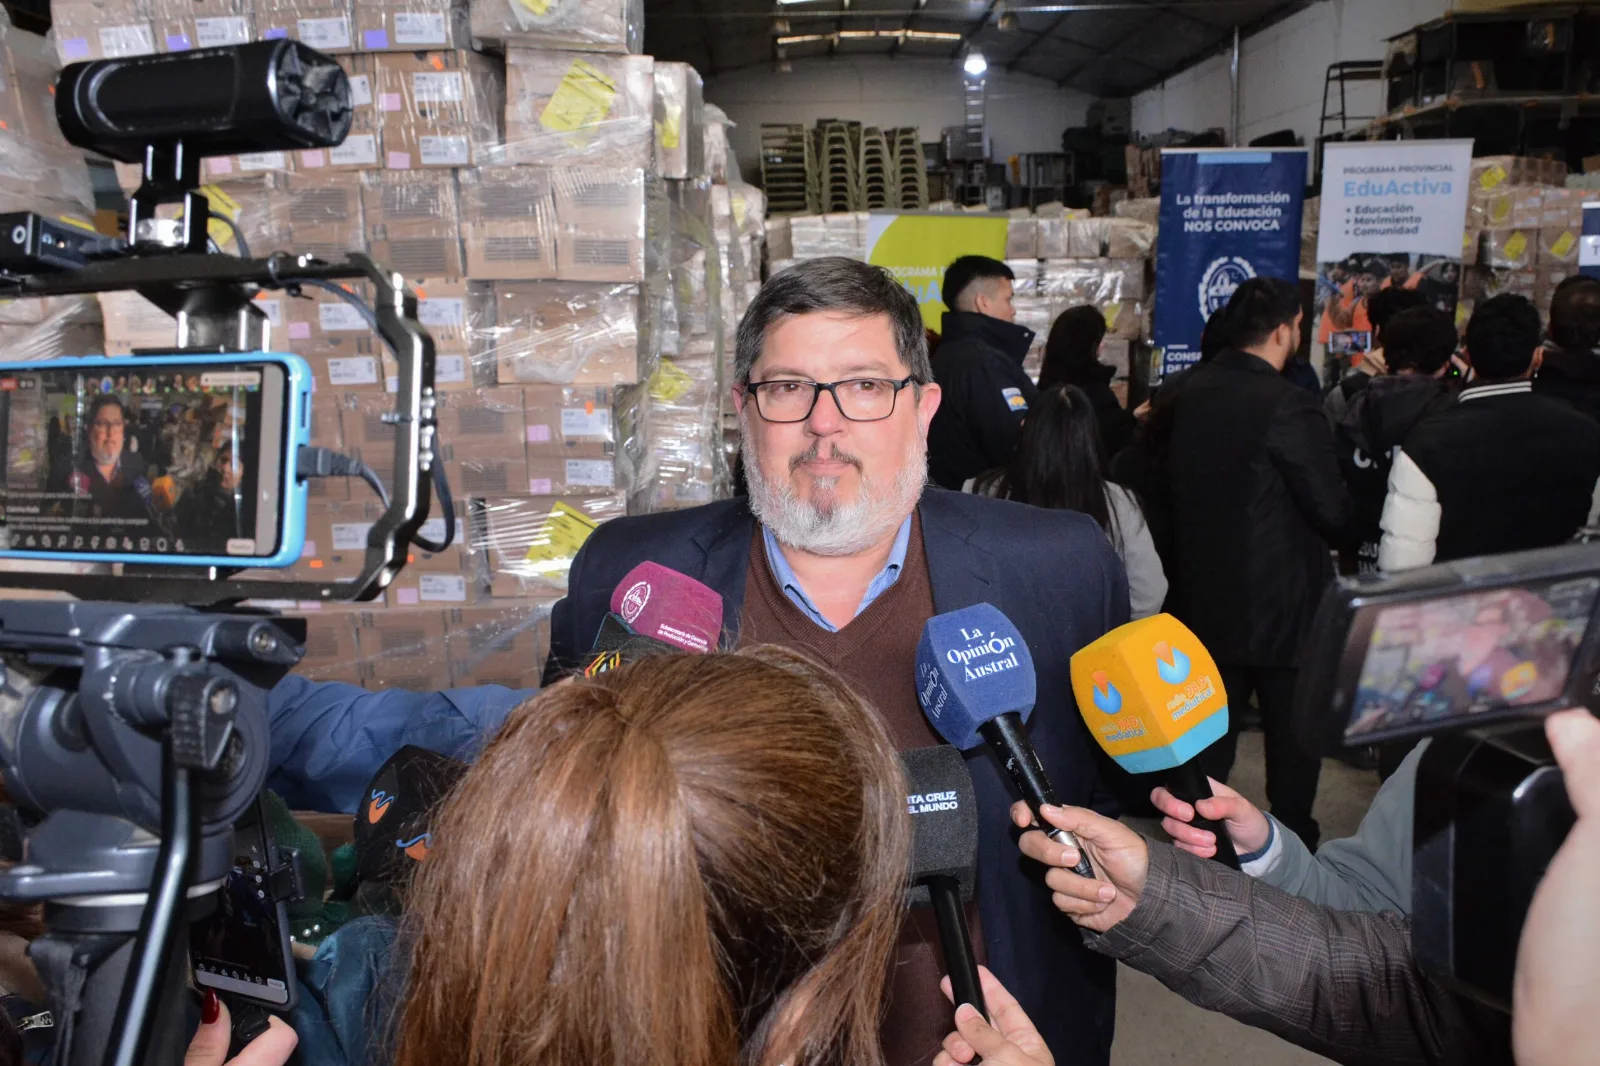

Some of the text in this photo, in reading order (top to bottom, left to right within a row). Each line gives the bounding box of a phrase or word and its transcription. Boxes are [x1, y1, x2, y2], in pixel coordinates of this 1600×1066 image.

[1343, 164, 1454, 174] PROGRAMA PROVINCIAL
[1343, 177, 1453, 197] EduActiva
[1176, 190, 1290, 205] La transformación
[1183, 205, 1282, 219] de la Educación
[1355, 204, 1414, 214] Educación
[1183, 219, 1280, 232] NOS CONVOCA
[1354, 215, 1422, 225] Movimiento
[1353, 225, 1420, 236] Comunidad
[960, 628, 983, 641] La
[964, 652, 1019, 682] Austral
[925, 791, 957, 803] CRUZ
[919, 801, 958, 813] MUNDO
